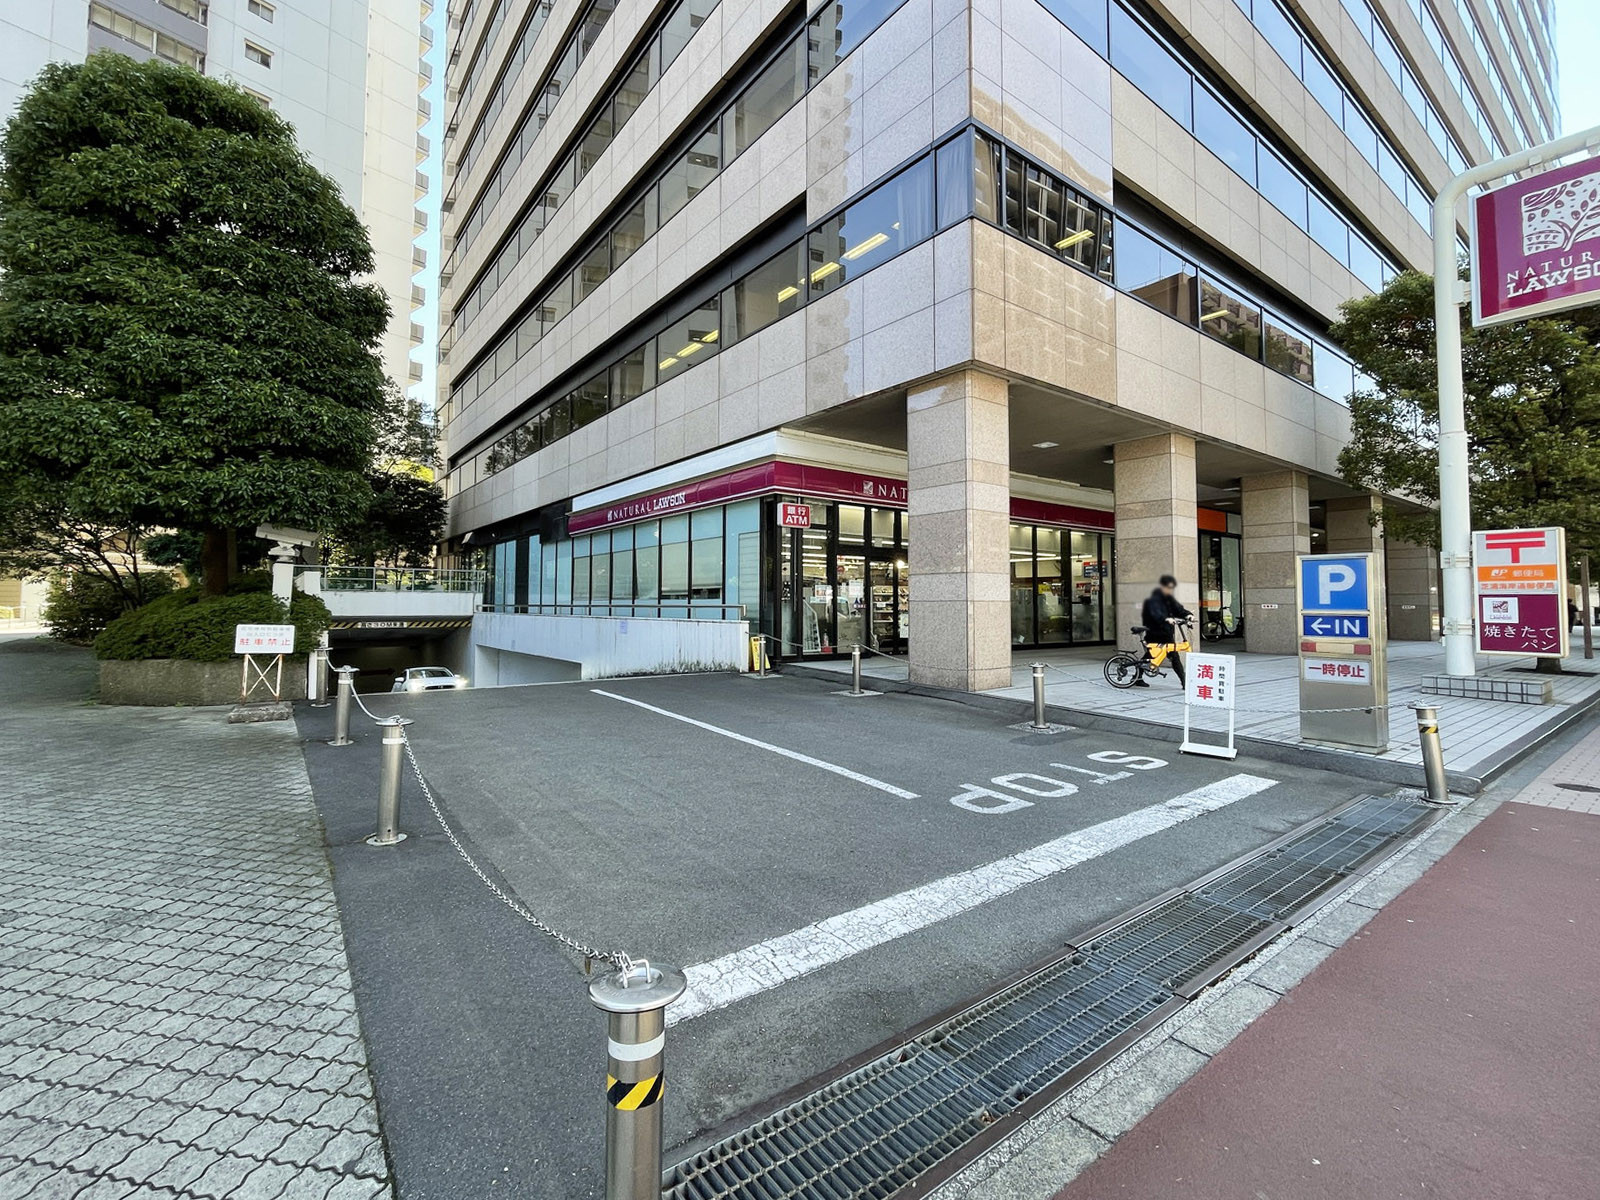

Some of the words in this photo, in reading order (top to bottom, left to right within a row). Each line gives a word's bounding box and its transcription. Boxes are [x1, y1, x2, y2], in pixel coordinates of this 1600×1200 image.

[1506, 251, 1594, 283] NATUR
[613, 501, 652, 520] NATURAL
[653, 492, 686, 511] LAWSON
[787, 505, 806, 516] 銀行
[785, 515, 808, 525] ATM
[1318, 564, 1356, 605] P
[1335, 618, 1360, 635] IN
[1484, 624, 1556, 639] 焼きたて
[1521, 639, 1557, 651] パン
[1308, 663, 1366, 678] 一時停止
[1196, 664, 1215, 701] 満車
[949, 750, 1169, 814] STOP
